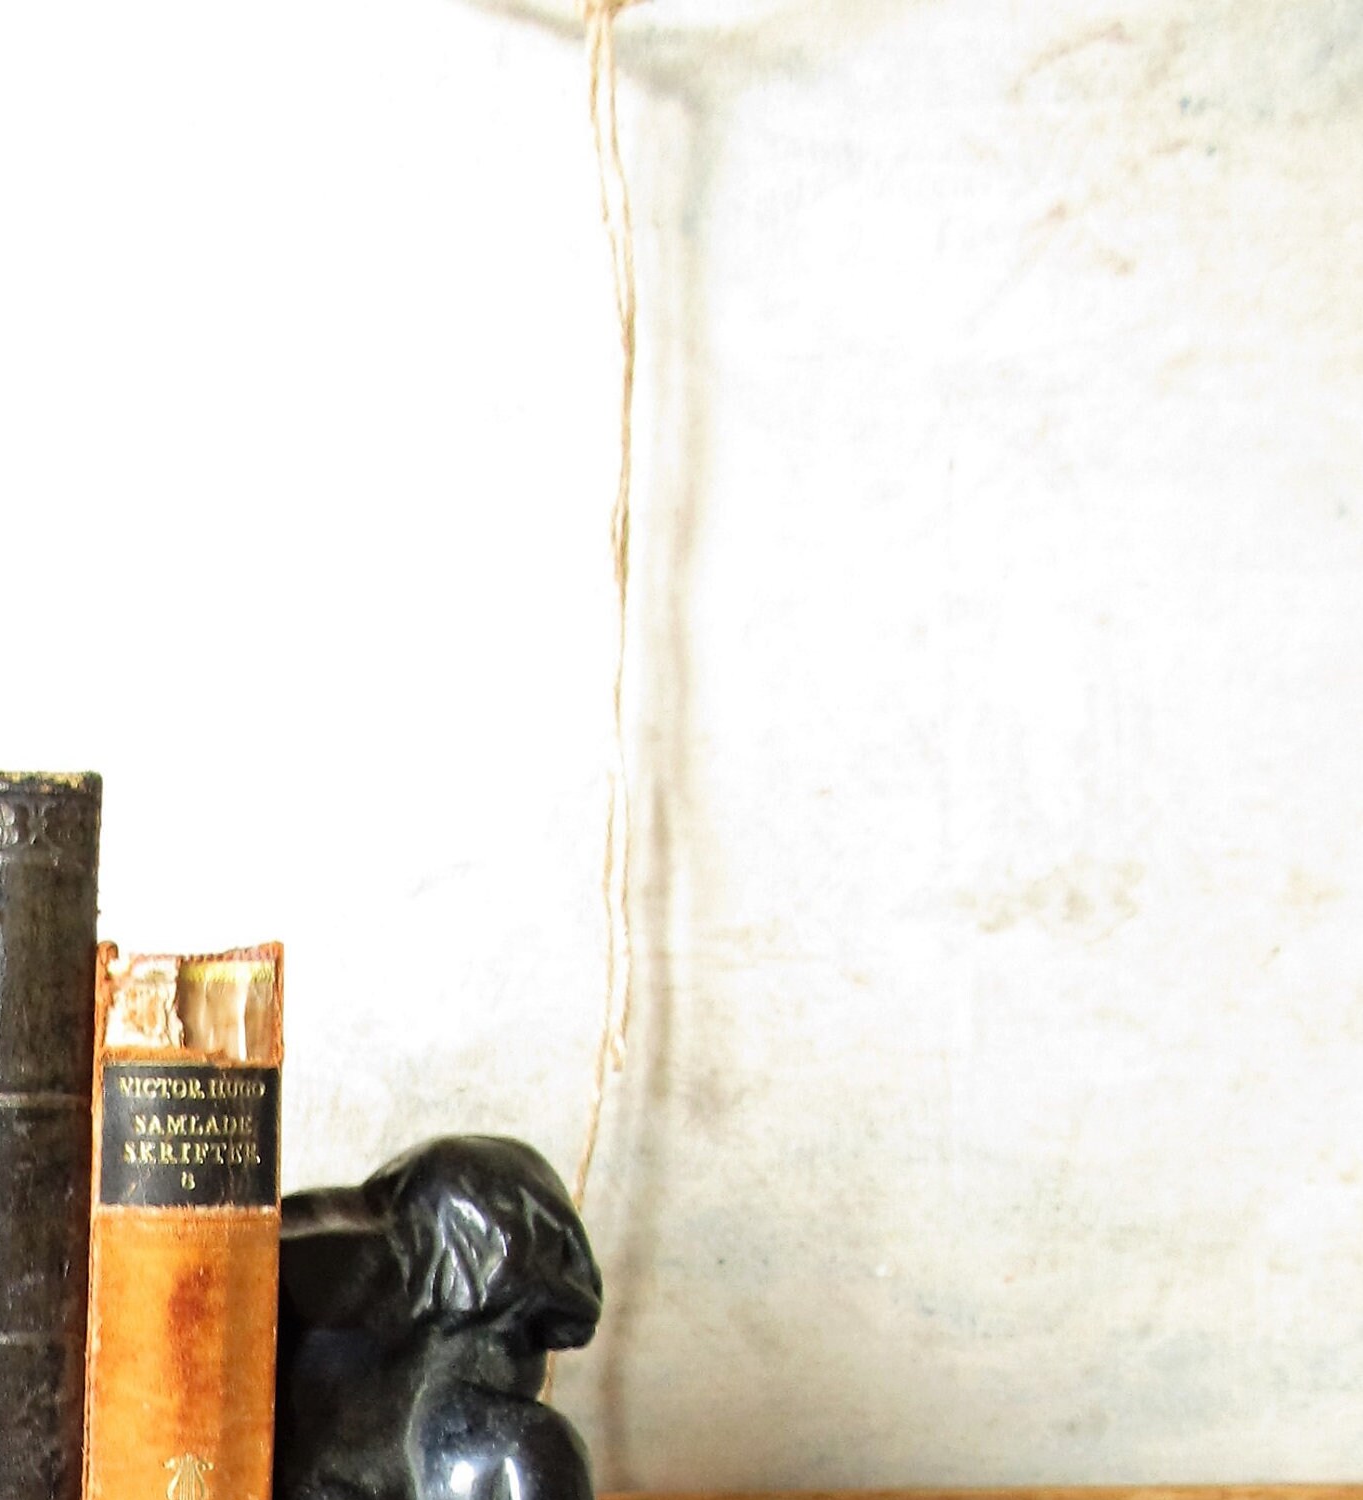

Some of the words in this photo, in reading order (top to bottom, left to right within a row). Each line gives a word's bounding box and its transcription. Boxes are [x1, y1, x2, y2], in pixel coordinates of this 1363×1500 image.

[120, 1076, 205, 1100] VICTOR
[209, 1078, 266, 1099] HUGO
[134, 1113, 253, 1137] SAMLADE
